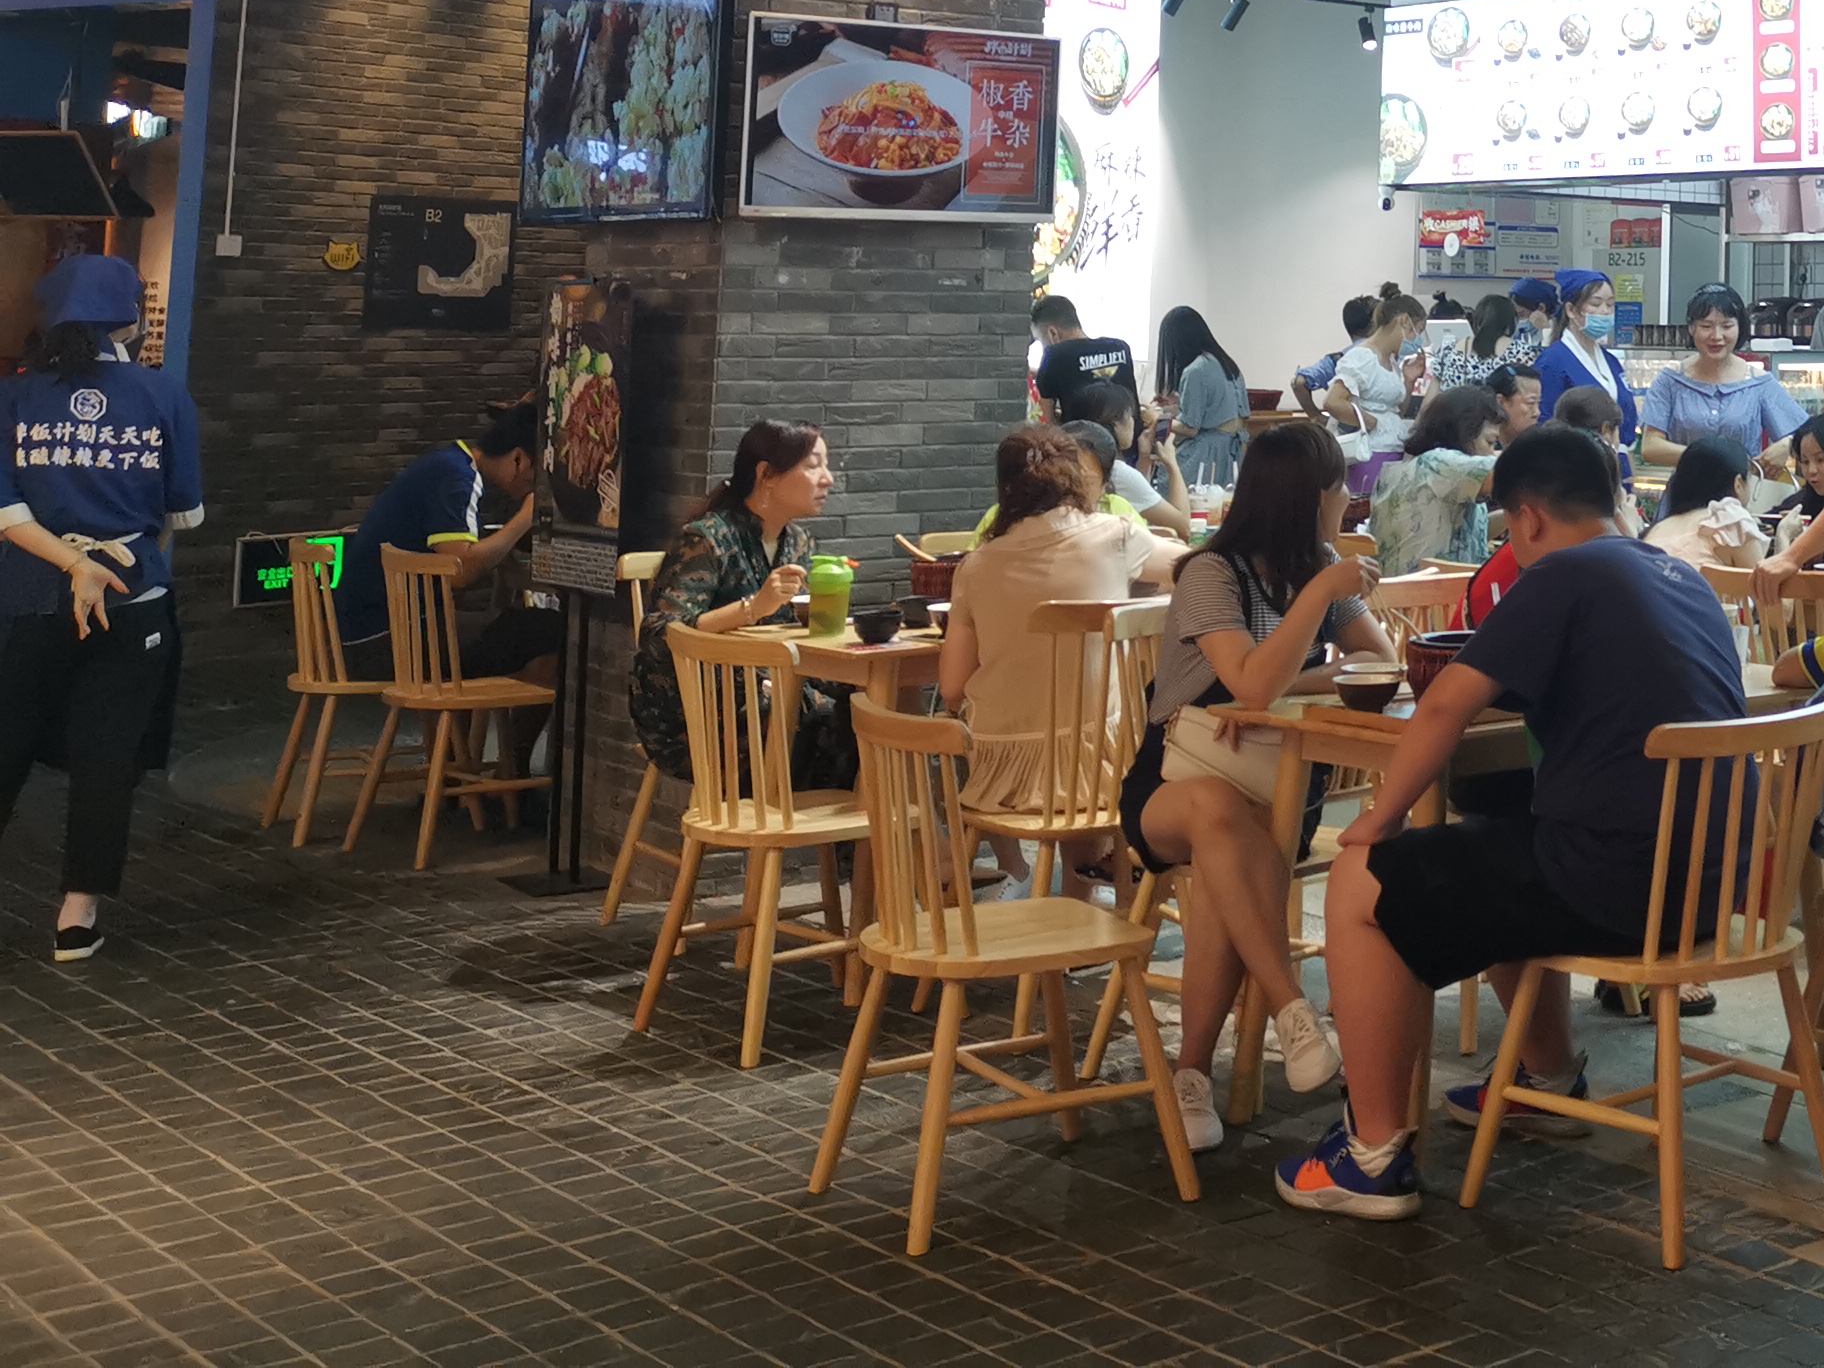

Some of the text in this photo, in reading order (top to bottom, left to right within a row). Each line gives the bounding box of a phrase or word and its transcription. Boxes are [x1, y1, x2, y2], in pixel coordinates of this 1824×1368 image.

[977, 118, 1031, 150] 牛杂
[424, 208, 443, 223] B2
[264, 579, 289, 590] EXIT
